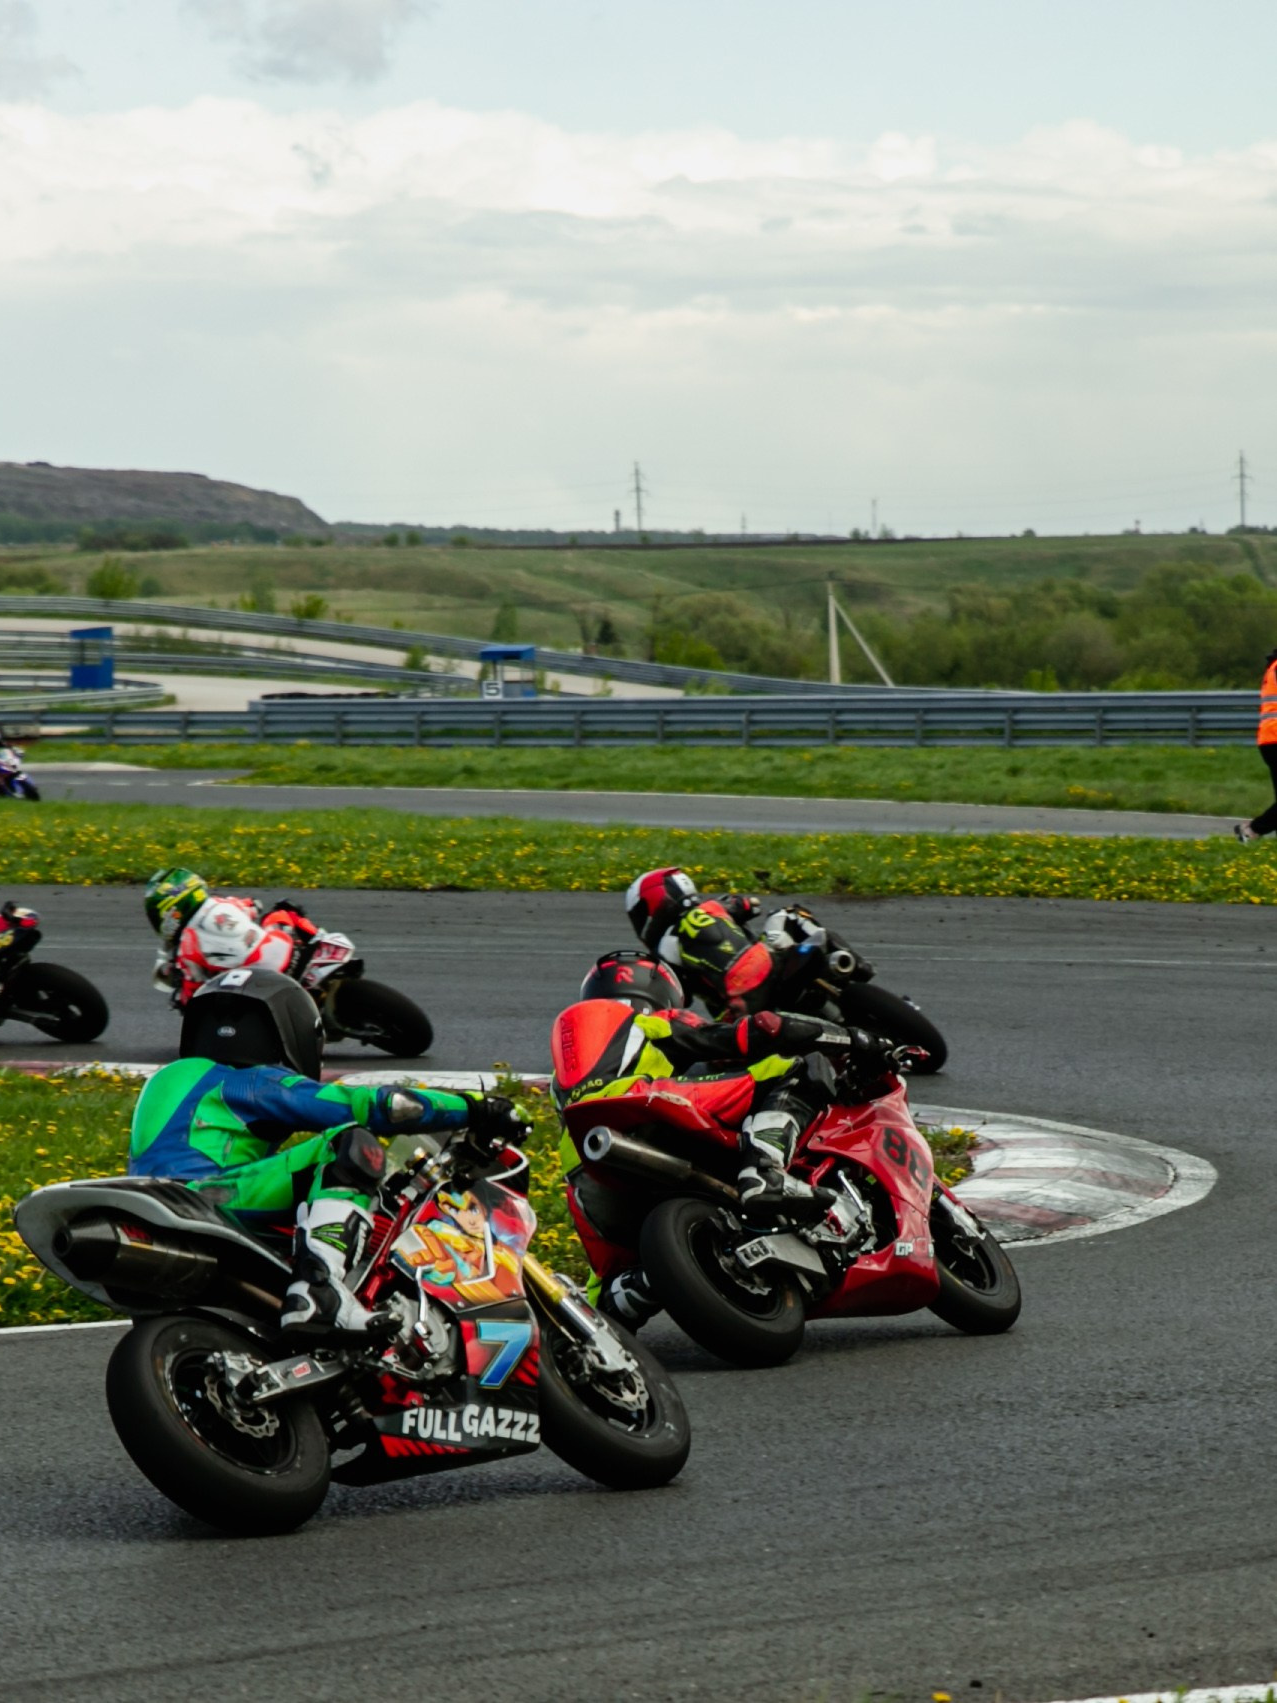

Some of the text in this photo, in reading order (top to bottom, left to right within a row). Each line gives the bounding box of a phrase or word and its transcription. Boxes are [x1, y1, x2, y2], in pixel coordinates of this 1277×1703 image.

[485, 682, 500, 697] 5
[679, 908, 716, 939] 16
[476, 1319, 533, 1389] 7
